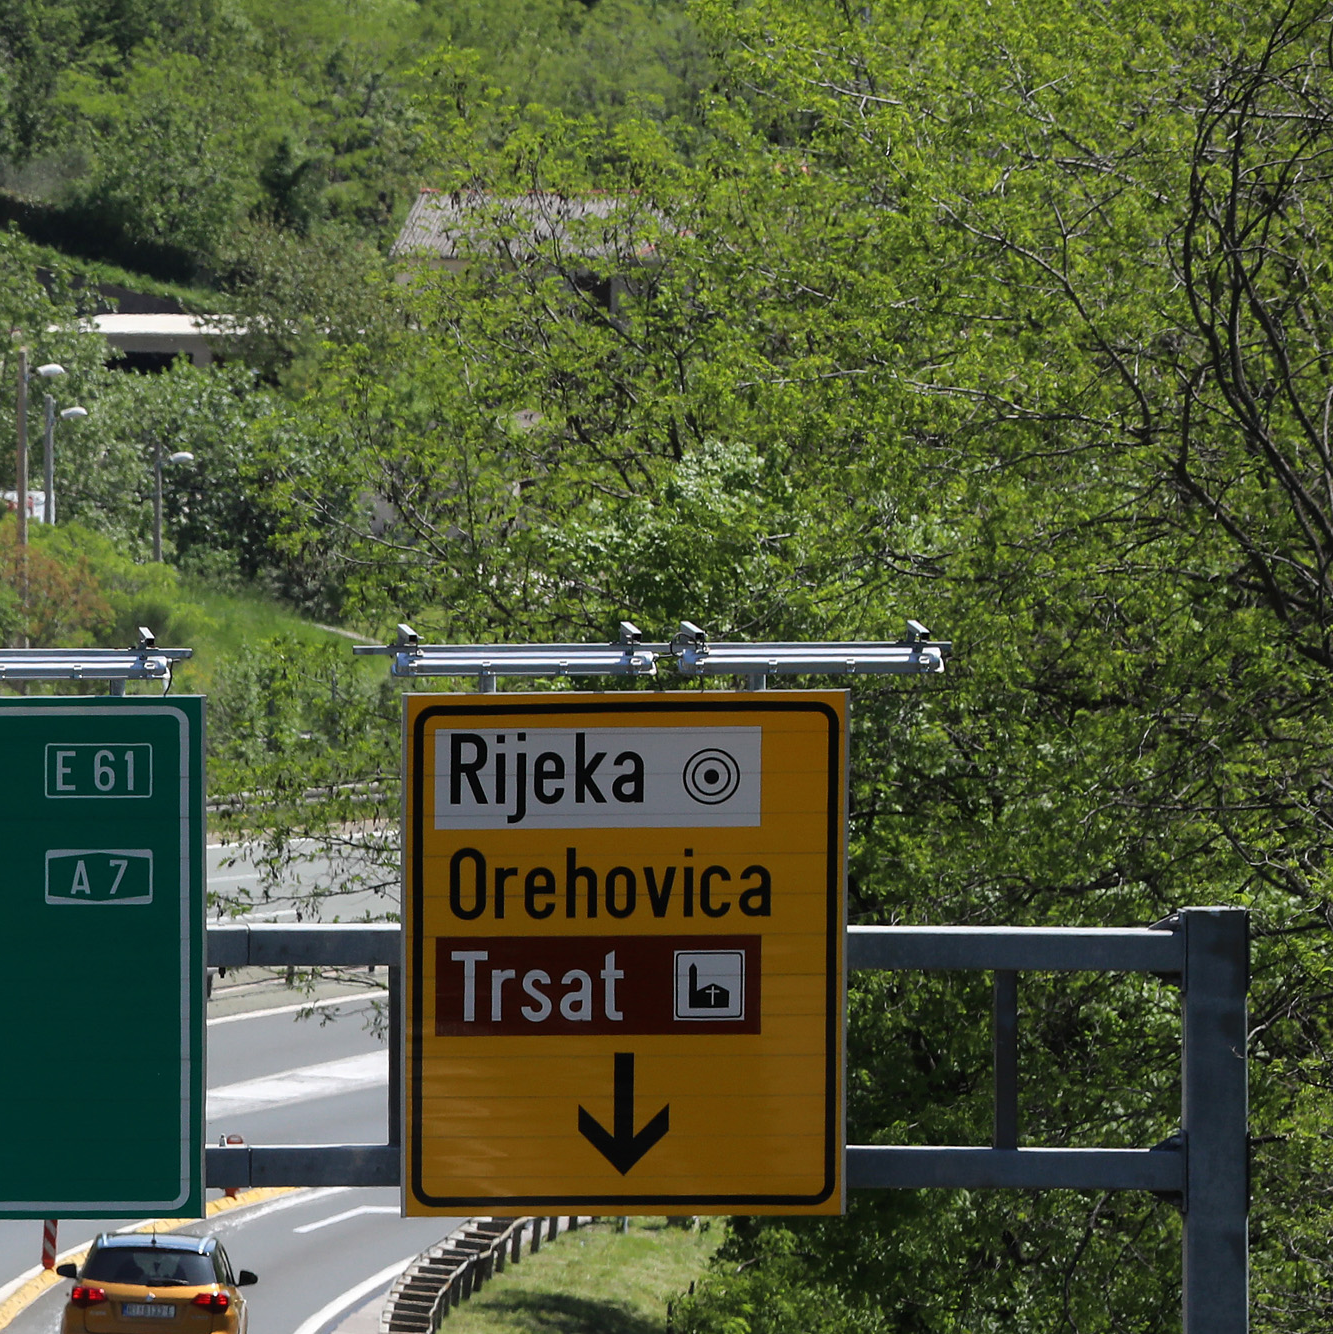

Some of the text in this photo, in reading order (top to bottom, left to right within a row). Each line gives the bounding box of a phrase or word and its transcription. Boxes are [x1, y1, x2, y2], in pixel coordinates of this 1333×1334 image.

[55, 749, 135, 791] E 61
[449, 731, 645, 824] Rijeka
[70, 858, 129, 896] A 7
[448, 847, 772, 921] Orehovica
[450, 949, 625, 1023] Trsat
